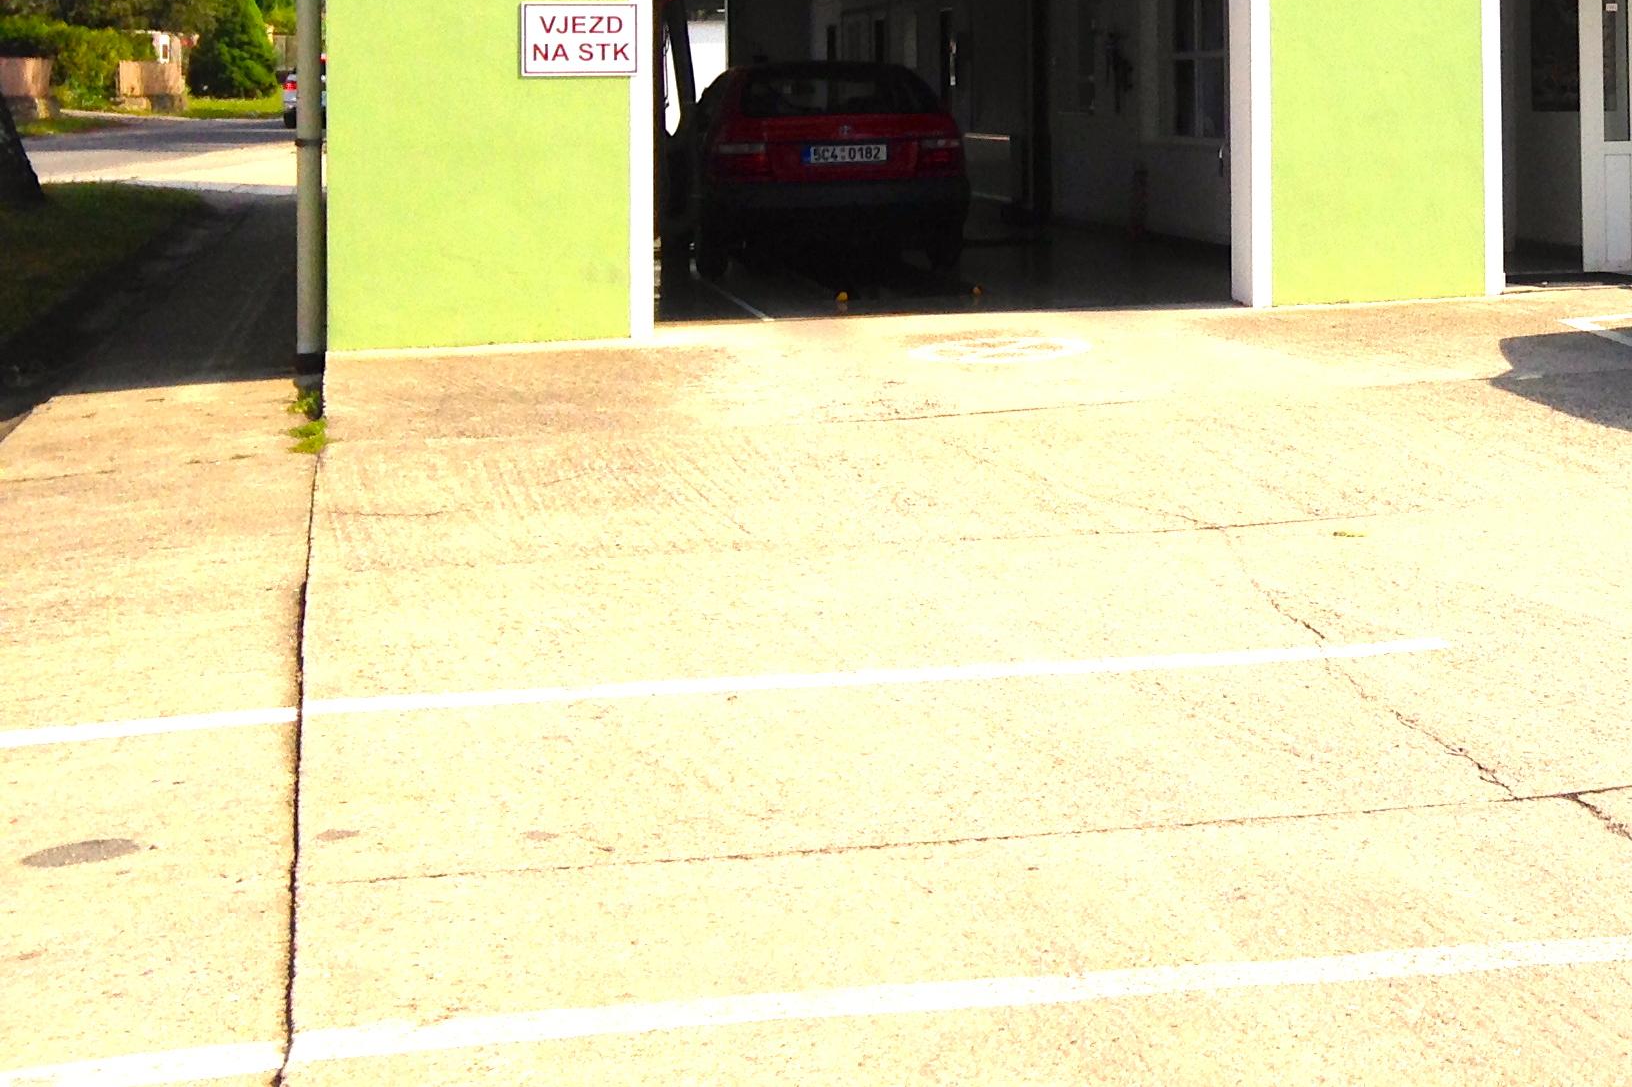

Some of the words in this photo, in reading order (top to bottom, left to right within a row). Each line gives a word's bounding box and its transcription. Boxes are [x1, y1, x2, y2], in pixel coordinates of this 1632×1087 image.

[539, 15, 623, 34] VJEZD
[533, 43, 570, 62] NA
[578, 43, 630, 62] STK
[813, 147, 838, 162] 5C4
[849, 146, 881, 160] 0182
